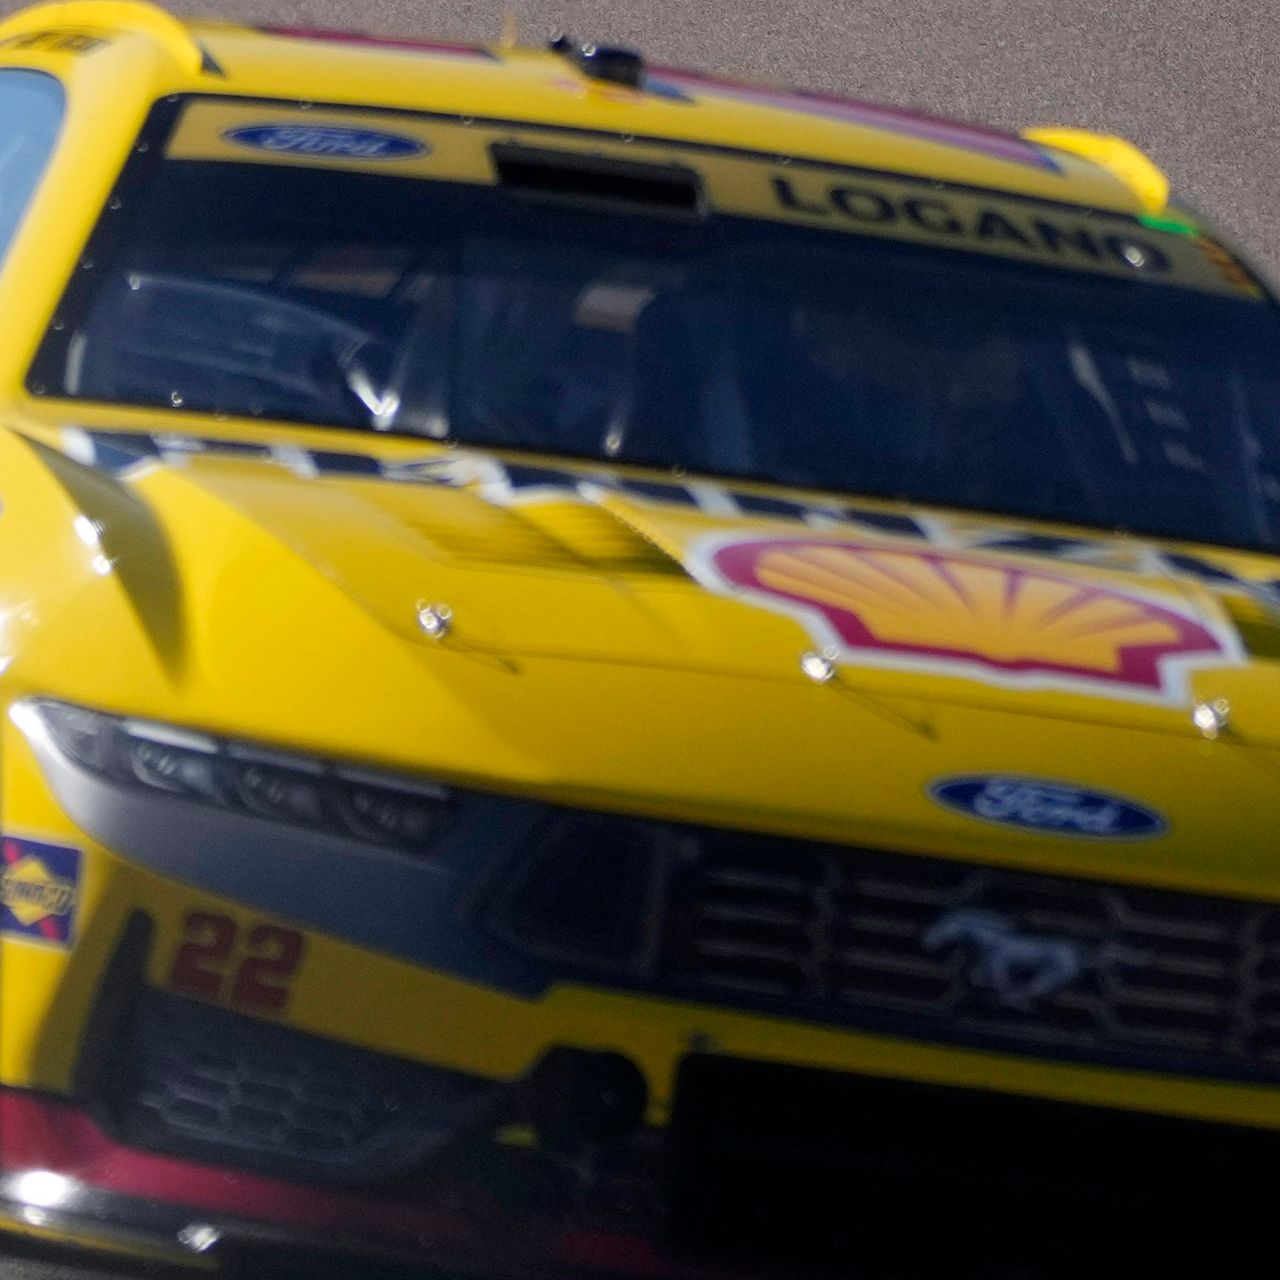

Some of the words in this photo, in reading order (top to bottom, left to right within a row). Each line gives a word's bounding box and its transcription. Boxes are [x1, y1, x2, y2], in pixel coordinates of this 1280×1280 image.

[771, 174, 1172, 275] LOGANO
[967, 779, 1125, 834] Ford
[172, 910, 304, 1010] 22
